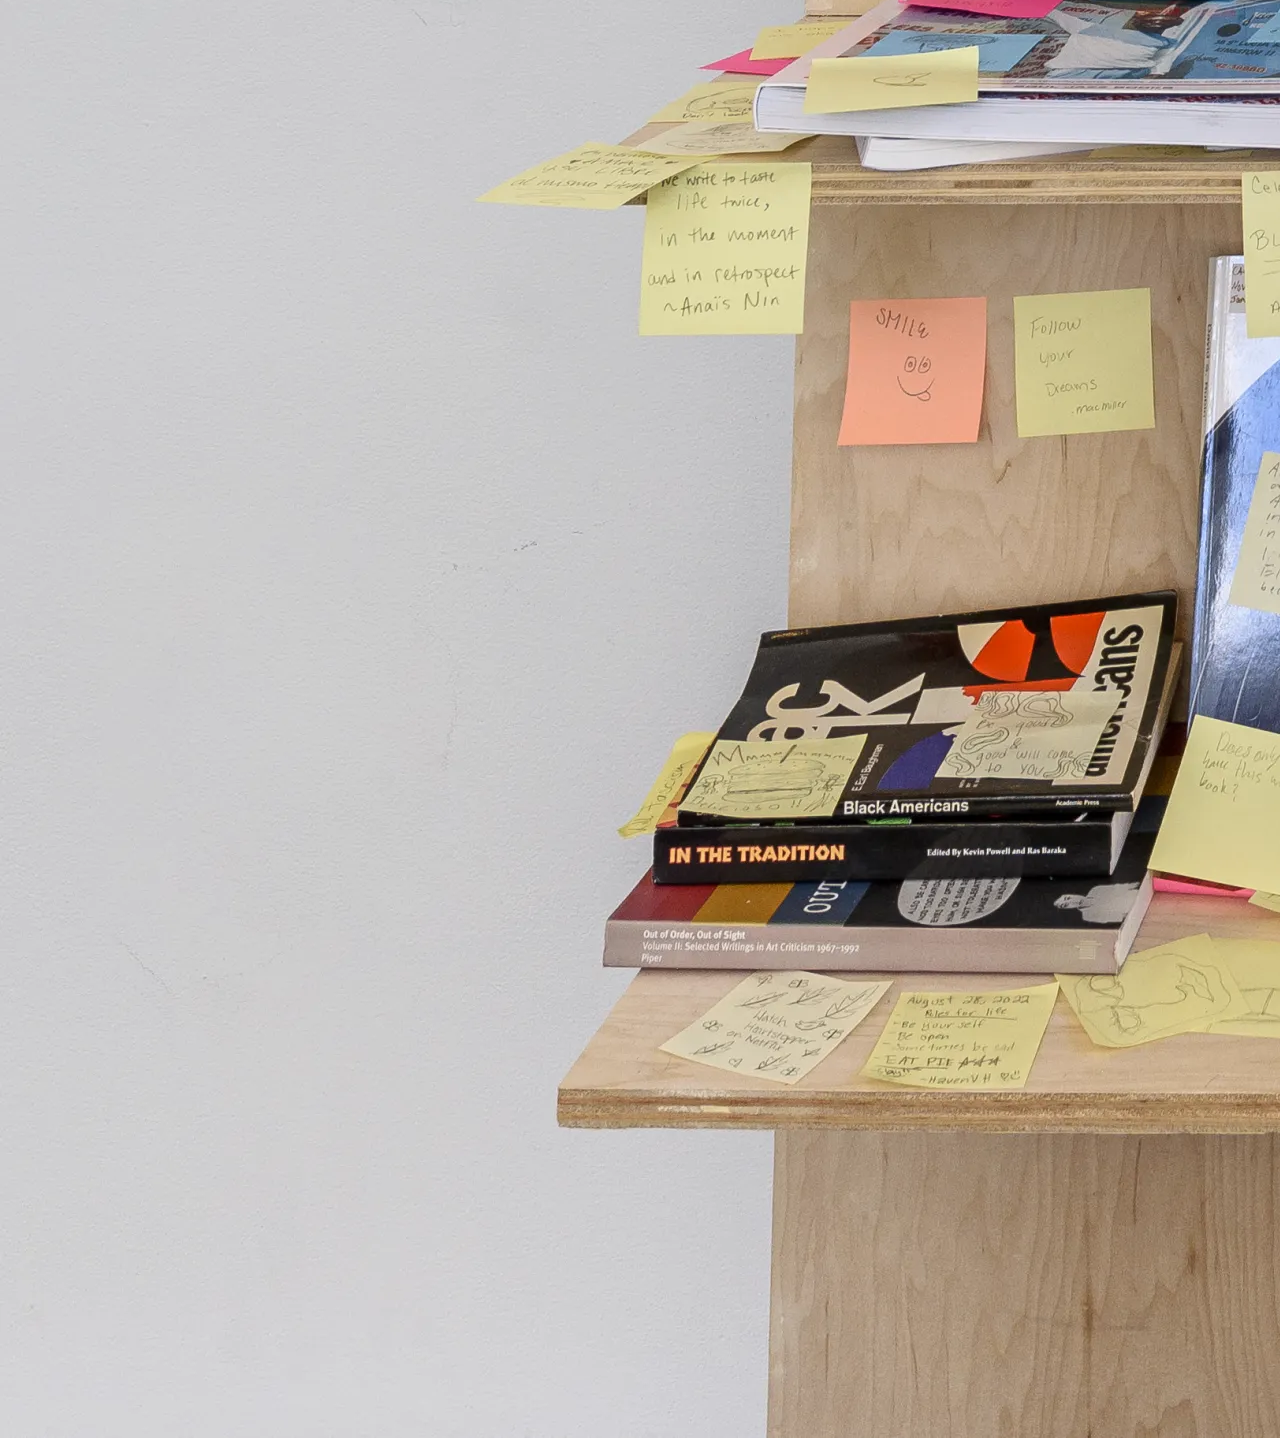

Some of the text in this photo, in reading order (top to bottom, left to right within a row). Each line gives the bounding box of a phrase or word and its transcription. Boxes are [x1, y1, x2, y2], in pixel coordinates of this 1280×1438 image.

[843, 799, 969, 815] Black Americans
[669, 845, 845, 864] IN THE TRADITION
[644, 930, 745, 941] Out of Order, Out of Sight
